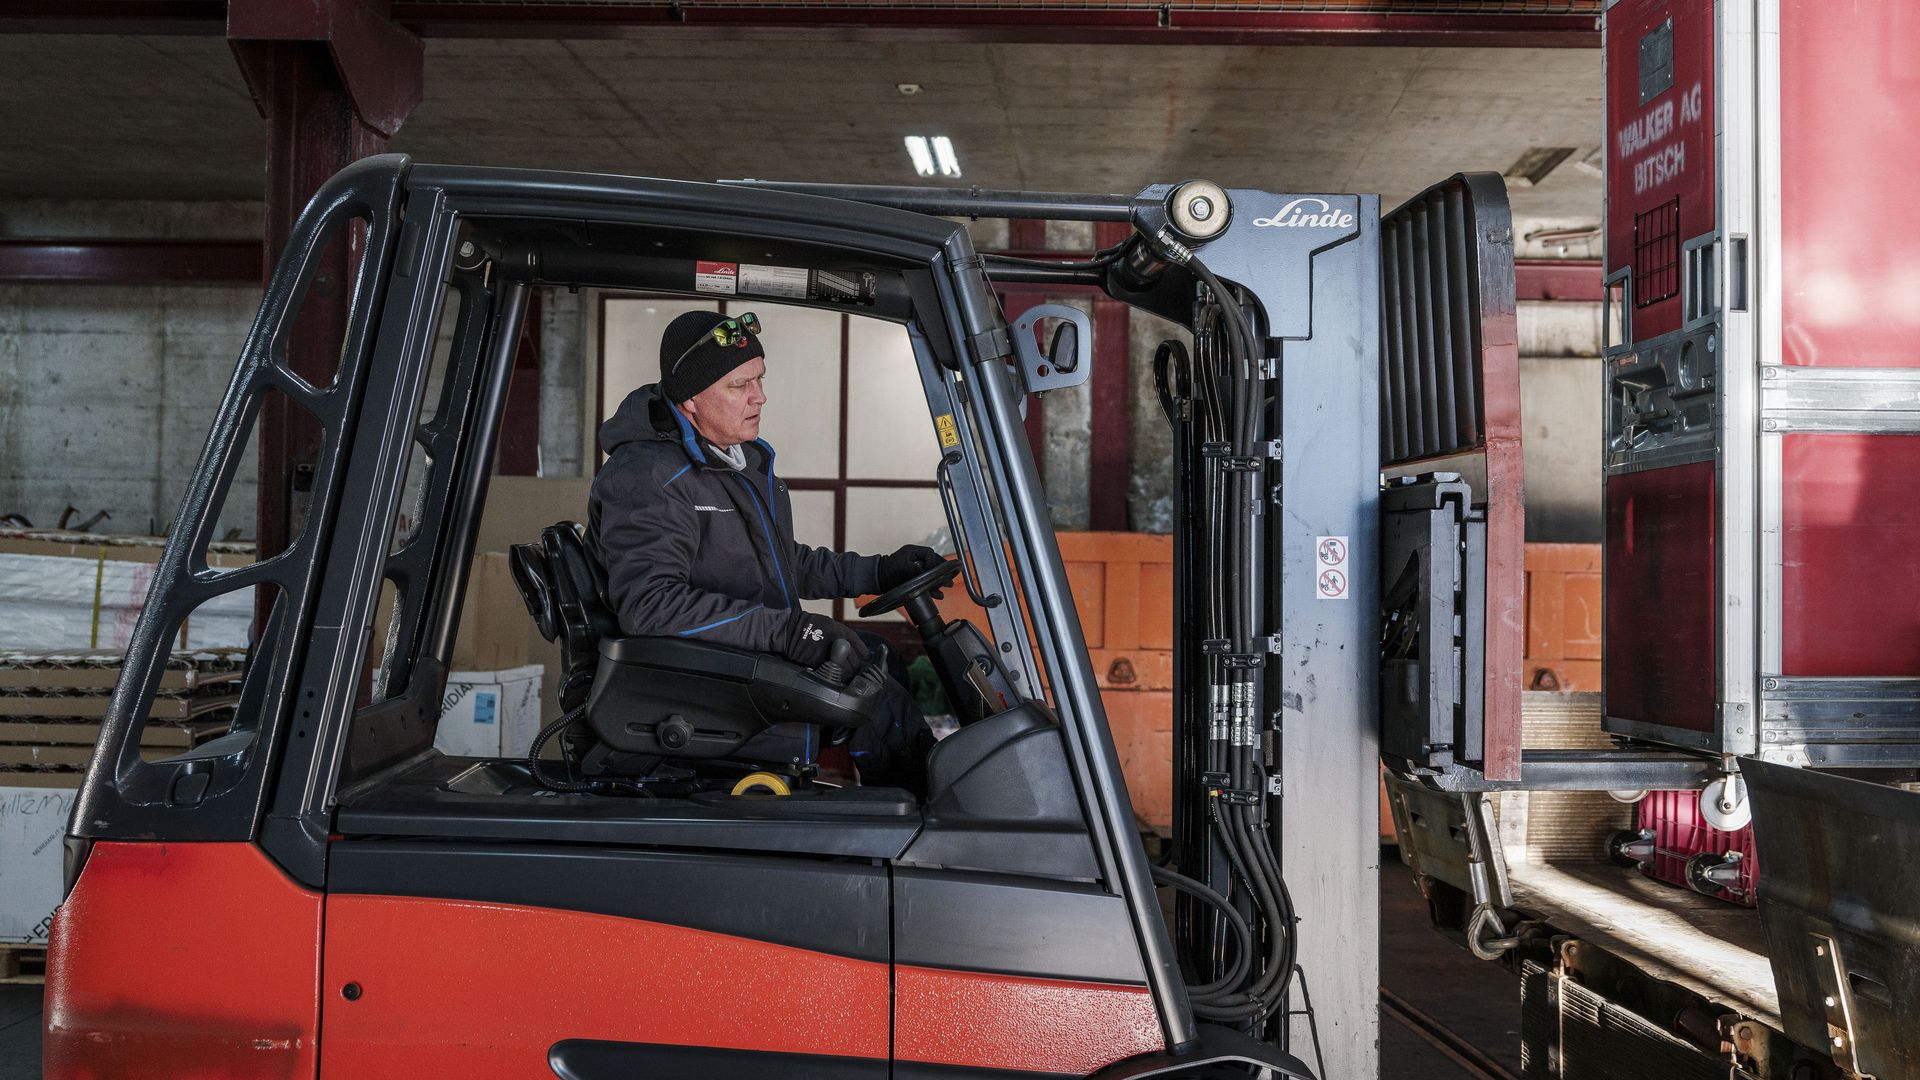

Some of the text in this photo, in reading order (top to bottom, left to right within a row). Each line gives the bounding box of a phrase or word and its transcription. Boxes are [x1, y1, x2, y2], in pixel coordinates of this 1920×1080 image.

[1618, 83, 1702, 158] WALKER AG
[1634, 141, 1685, 195] BITSCH
[1253, 198, 1353, 227] Linde
